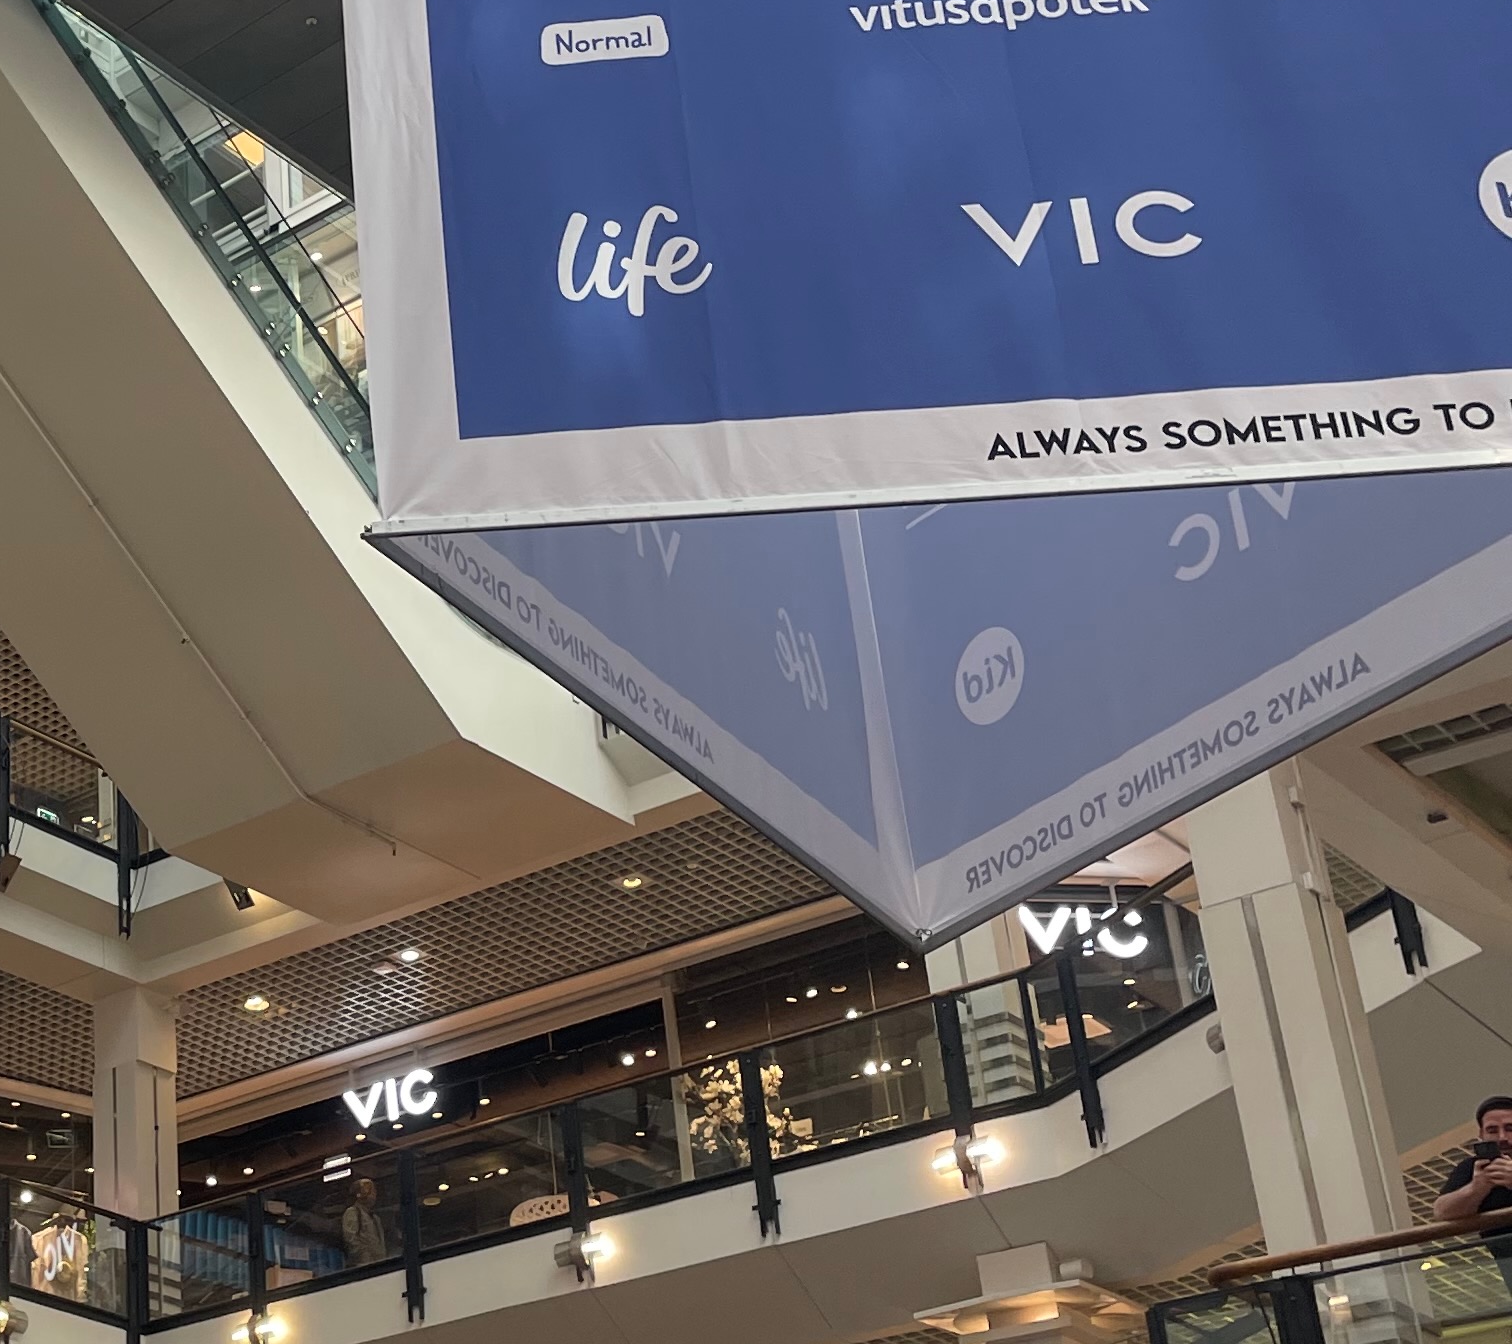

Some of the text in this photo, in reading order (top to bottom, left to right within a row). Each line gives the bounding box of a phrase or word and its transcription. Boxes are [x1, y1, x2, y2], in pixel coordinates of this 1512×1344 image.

[554, 25, 652, 56] Normal
[960, 189, 1203, 267] VIC
[557, 204, 714, 318] life
[987, 400, 1496, 462] ALWAYS SOMETHING TO
[342, 1068, 438, 1128] VIC
